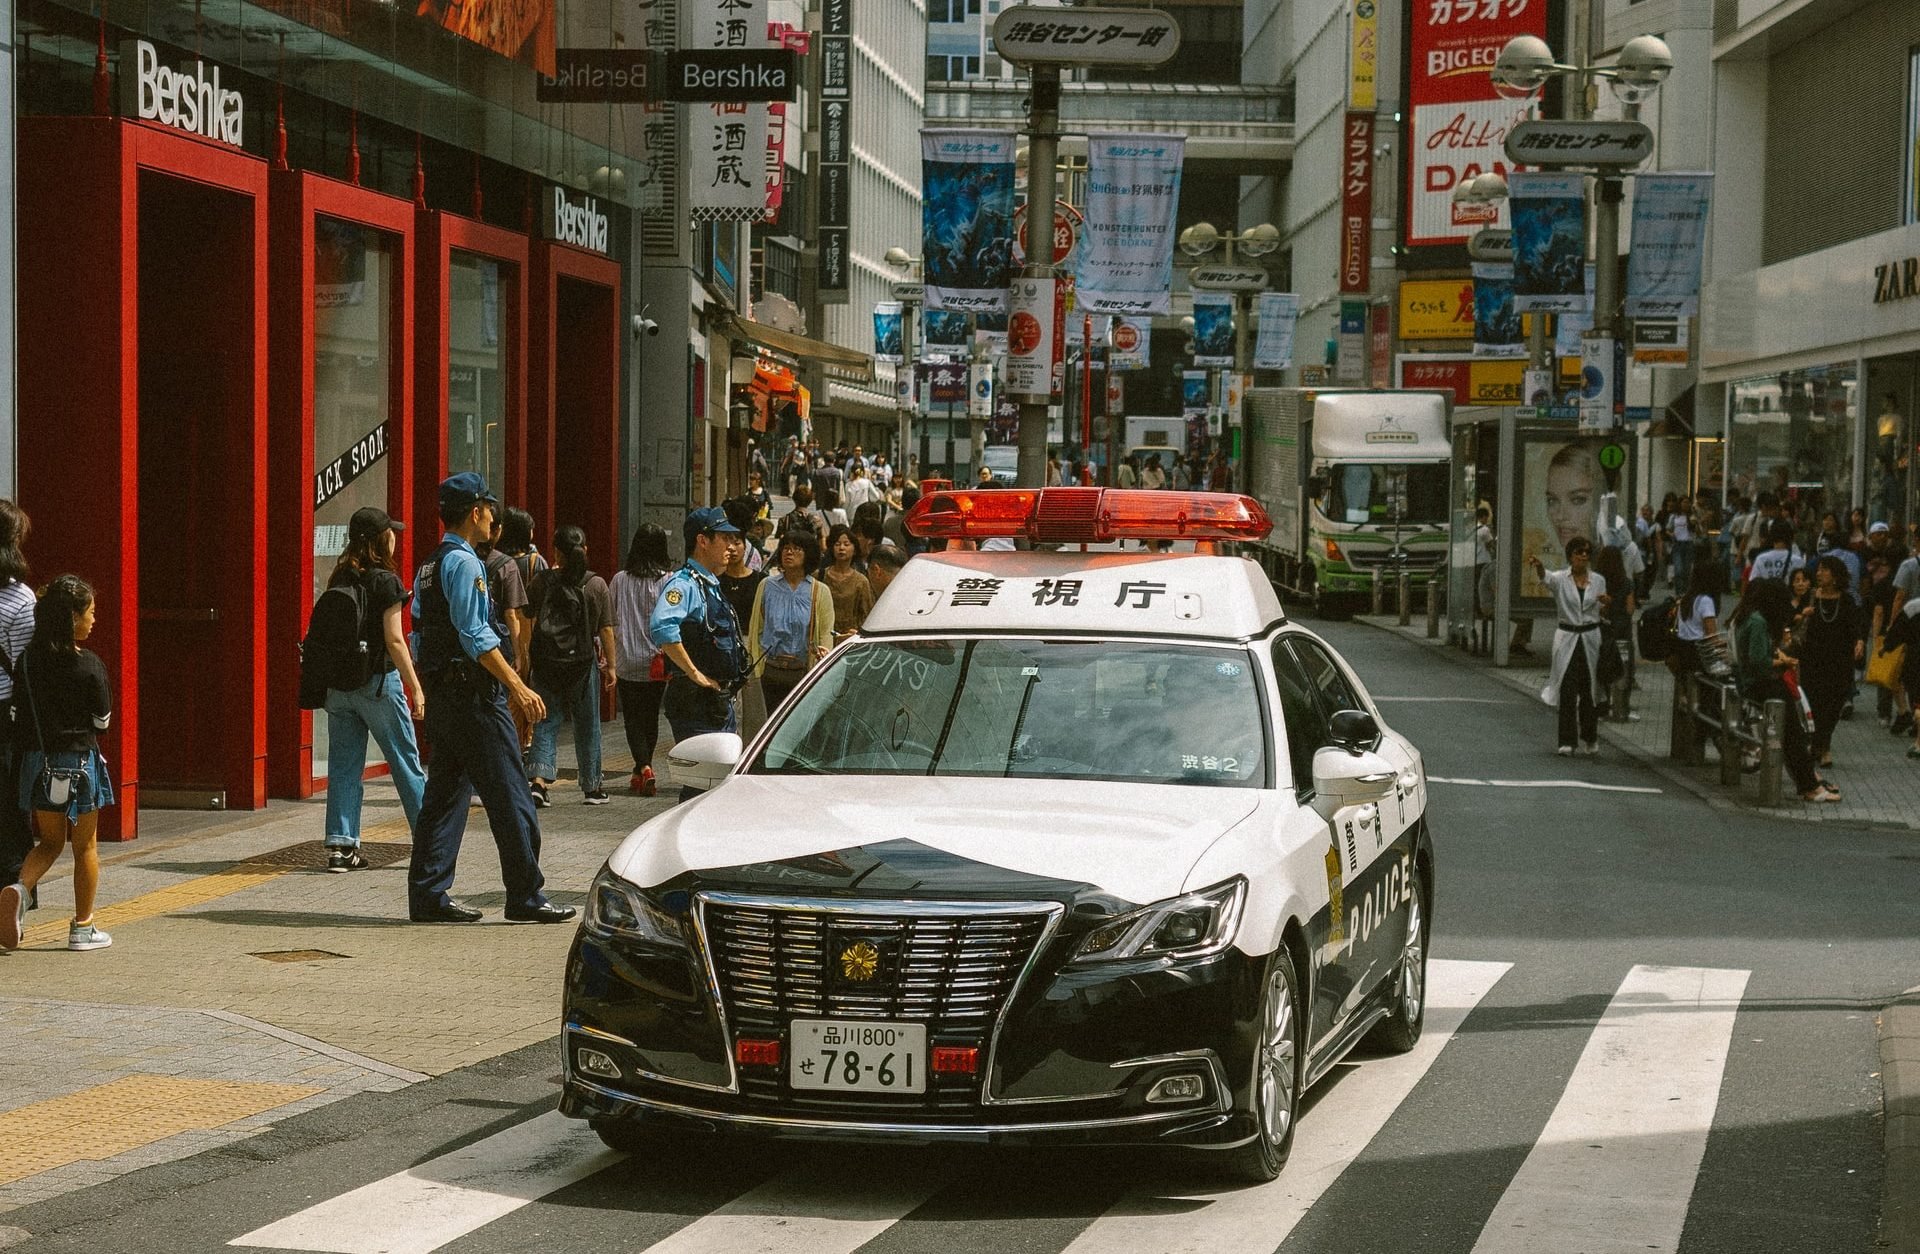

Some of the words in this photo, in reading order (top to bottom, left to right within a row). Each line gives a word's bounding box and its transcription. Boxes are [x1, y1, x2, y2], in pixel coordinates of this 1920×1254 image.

[1004, 22, 1169, 47] 渋谷センター街
[683, 64, 786, 88] Bershka
[1428, 49, 1468, 76] BIG
[138, 40, 243, 146] Bershka
[1347, 120, 1369, 196] カラオケ
[555, 186, 608, 254] Bershka
[1093, 223, 1132, 233] MONSTER
[1414, 367, 1456, 379] カラオケ
[316, 458, 344, 504] ACK
[351, 425, 385, 475] SOON
[950, 578, 1166, 609] 警視庁
[1348, 851, 1411, 958] POLICE
[799, 1058, 815, 1075] せ
[820, 1049, 912, 1087] 78-61
